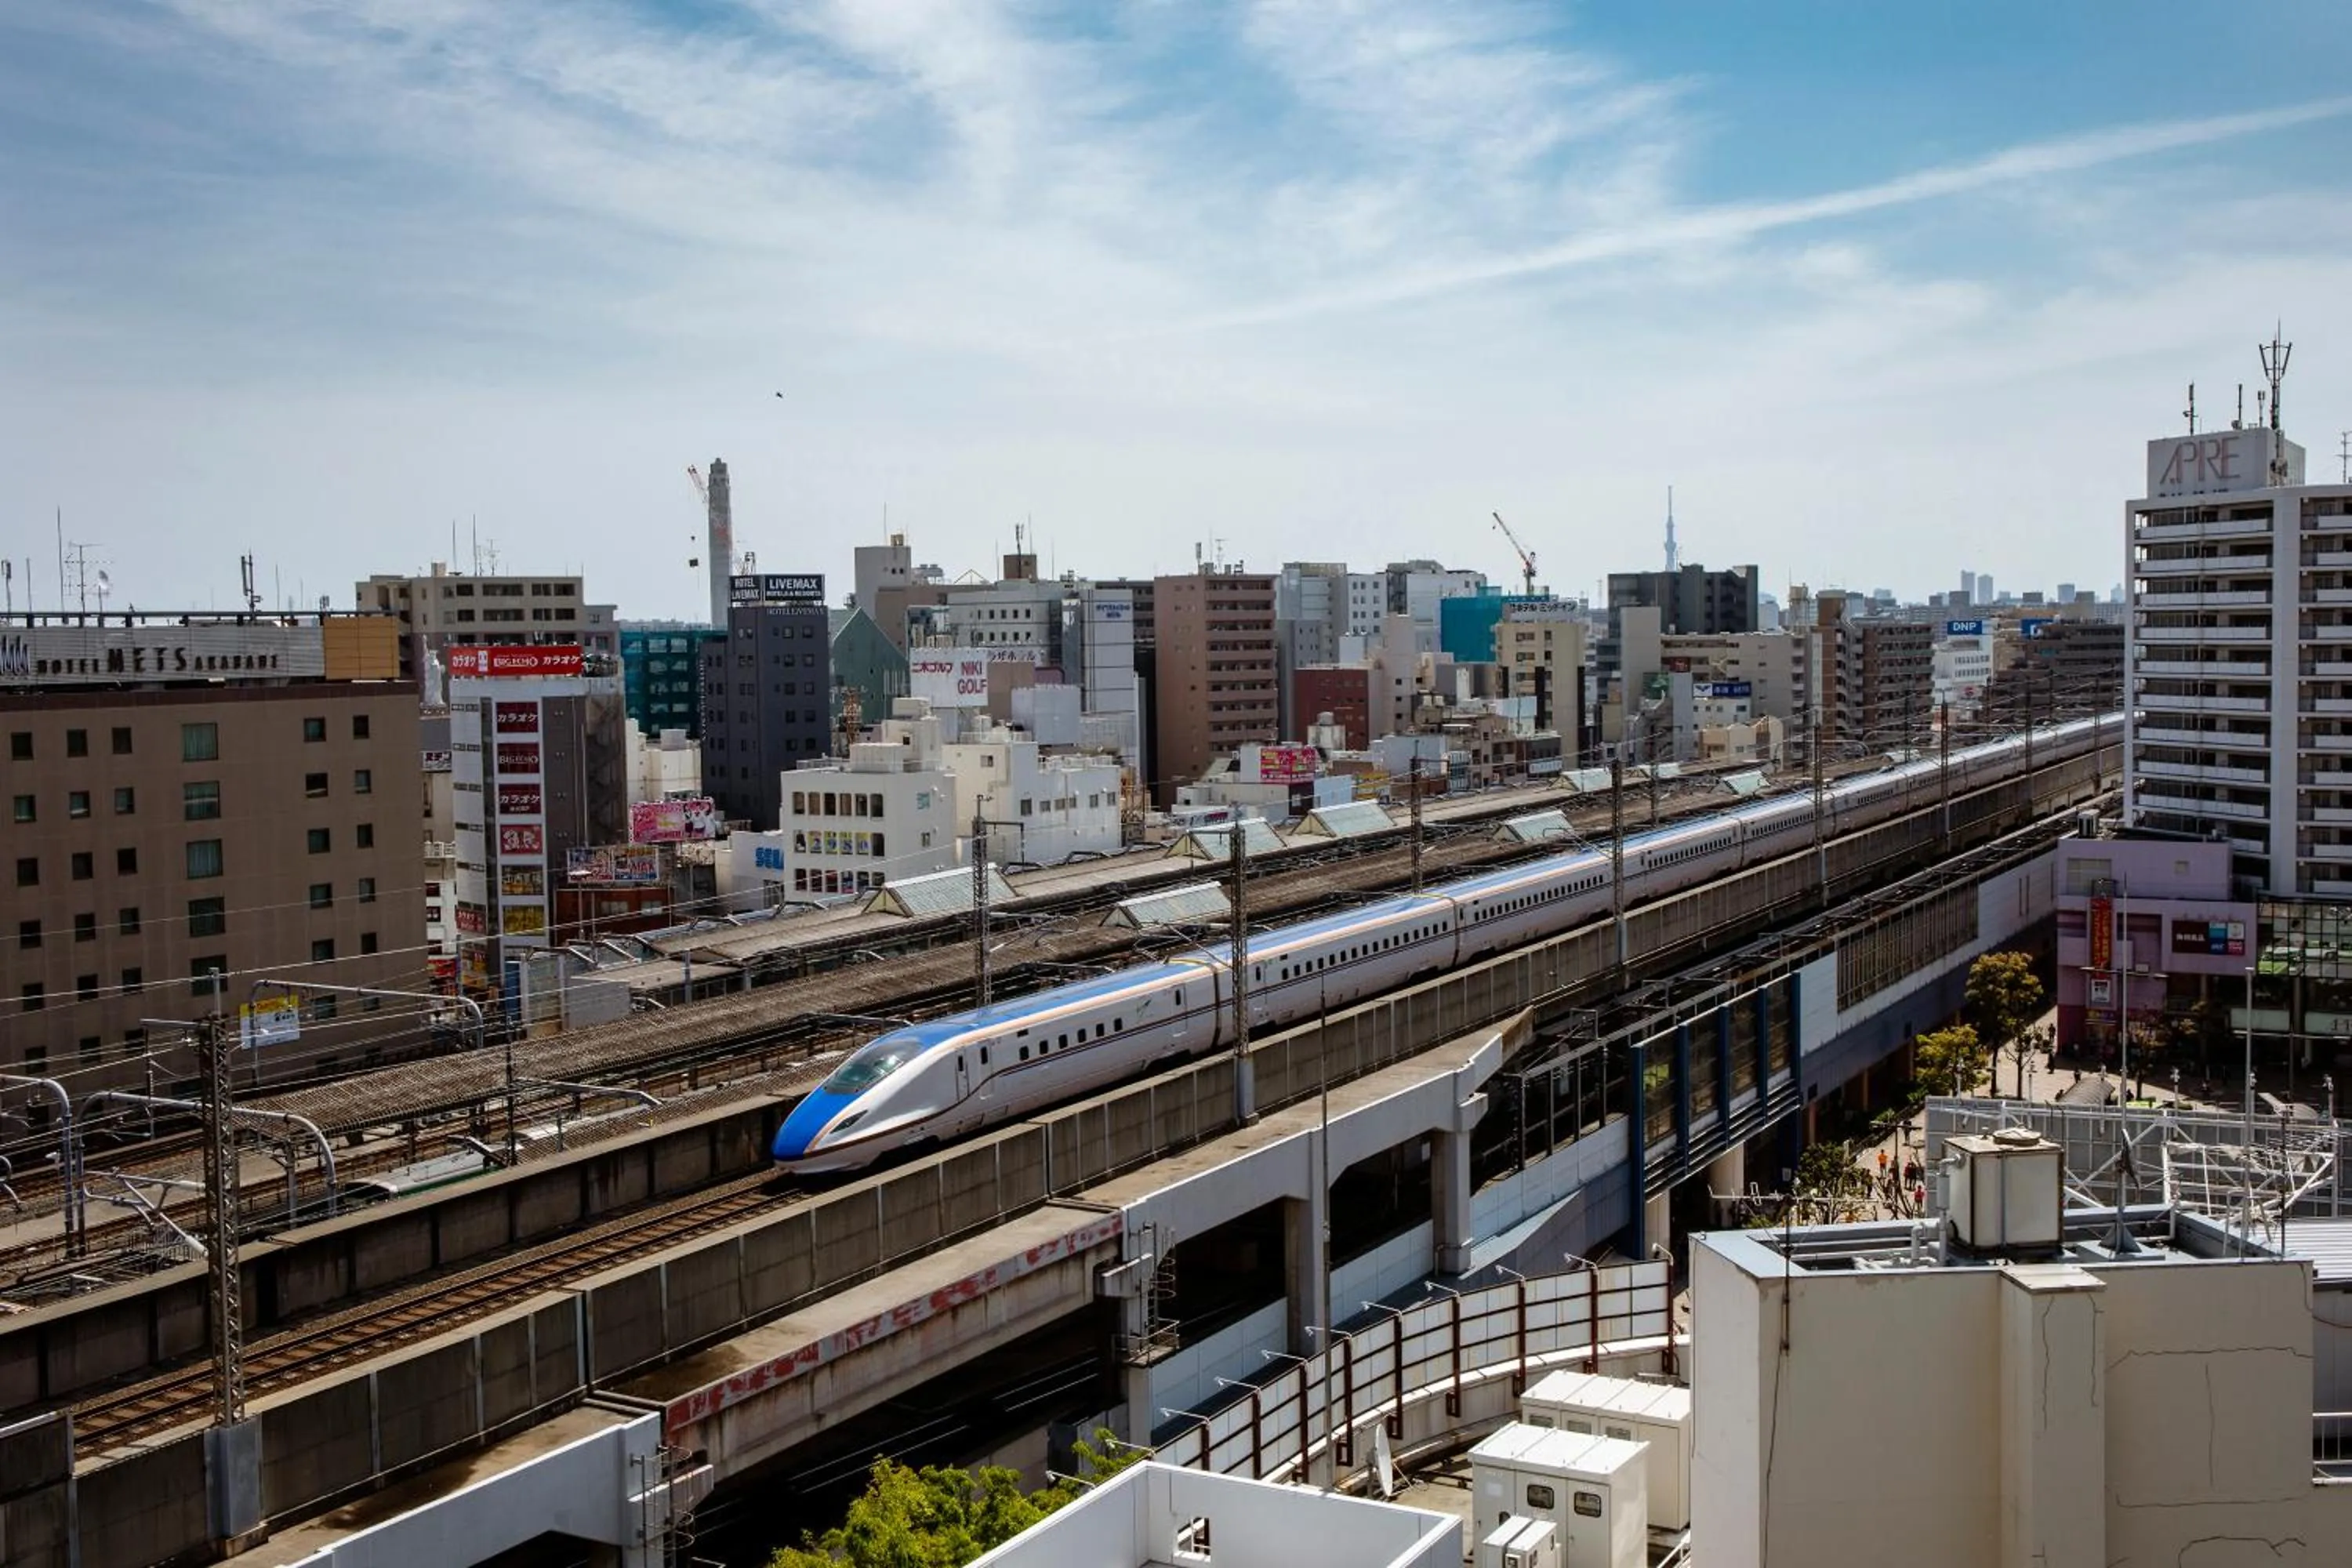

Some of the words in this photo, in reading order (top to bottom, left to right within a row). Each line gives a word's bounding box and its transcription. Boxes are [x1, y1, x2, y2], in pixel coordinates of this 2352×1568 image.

[2160, 436, 2241, 485] APRE
[769, 578, 817, 590] LIVEMAX
[1953, 622, 1976, 631] DNP
[107, 647, 187, 673] METS
[543, 655, 579, 666] カラオケ
[912, 662, 953, 673] 二木ゴルフ
[961, 661, 982, 676] NIKI
[957, 678, 987, 695] GOLF
[500, 795, 539, 804] カラオケ
[755, 847, 784, 869] SEG
